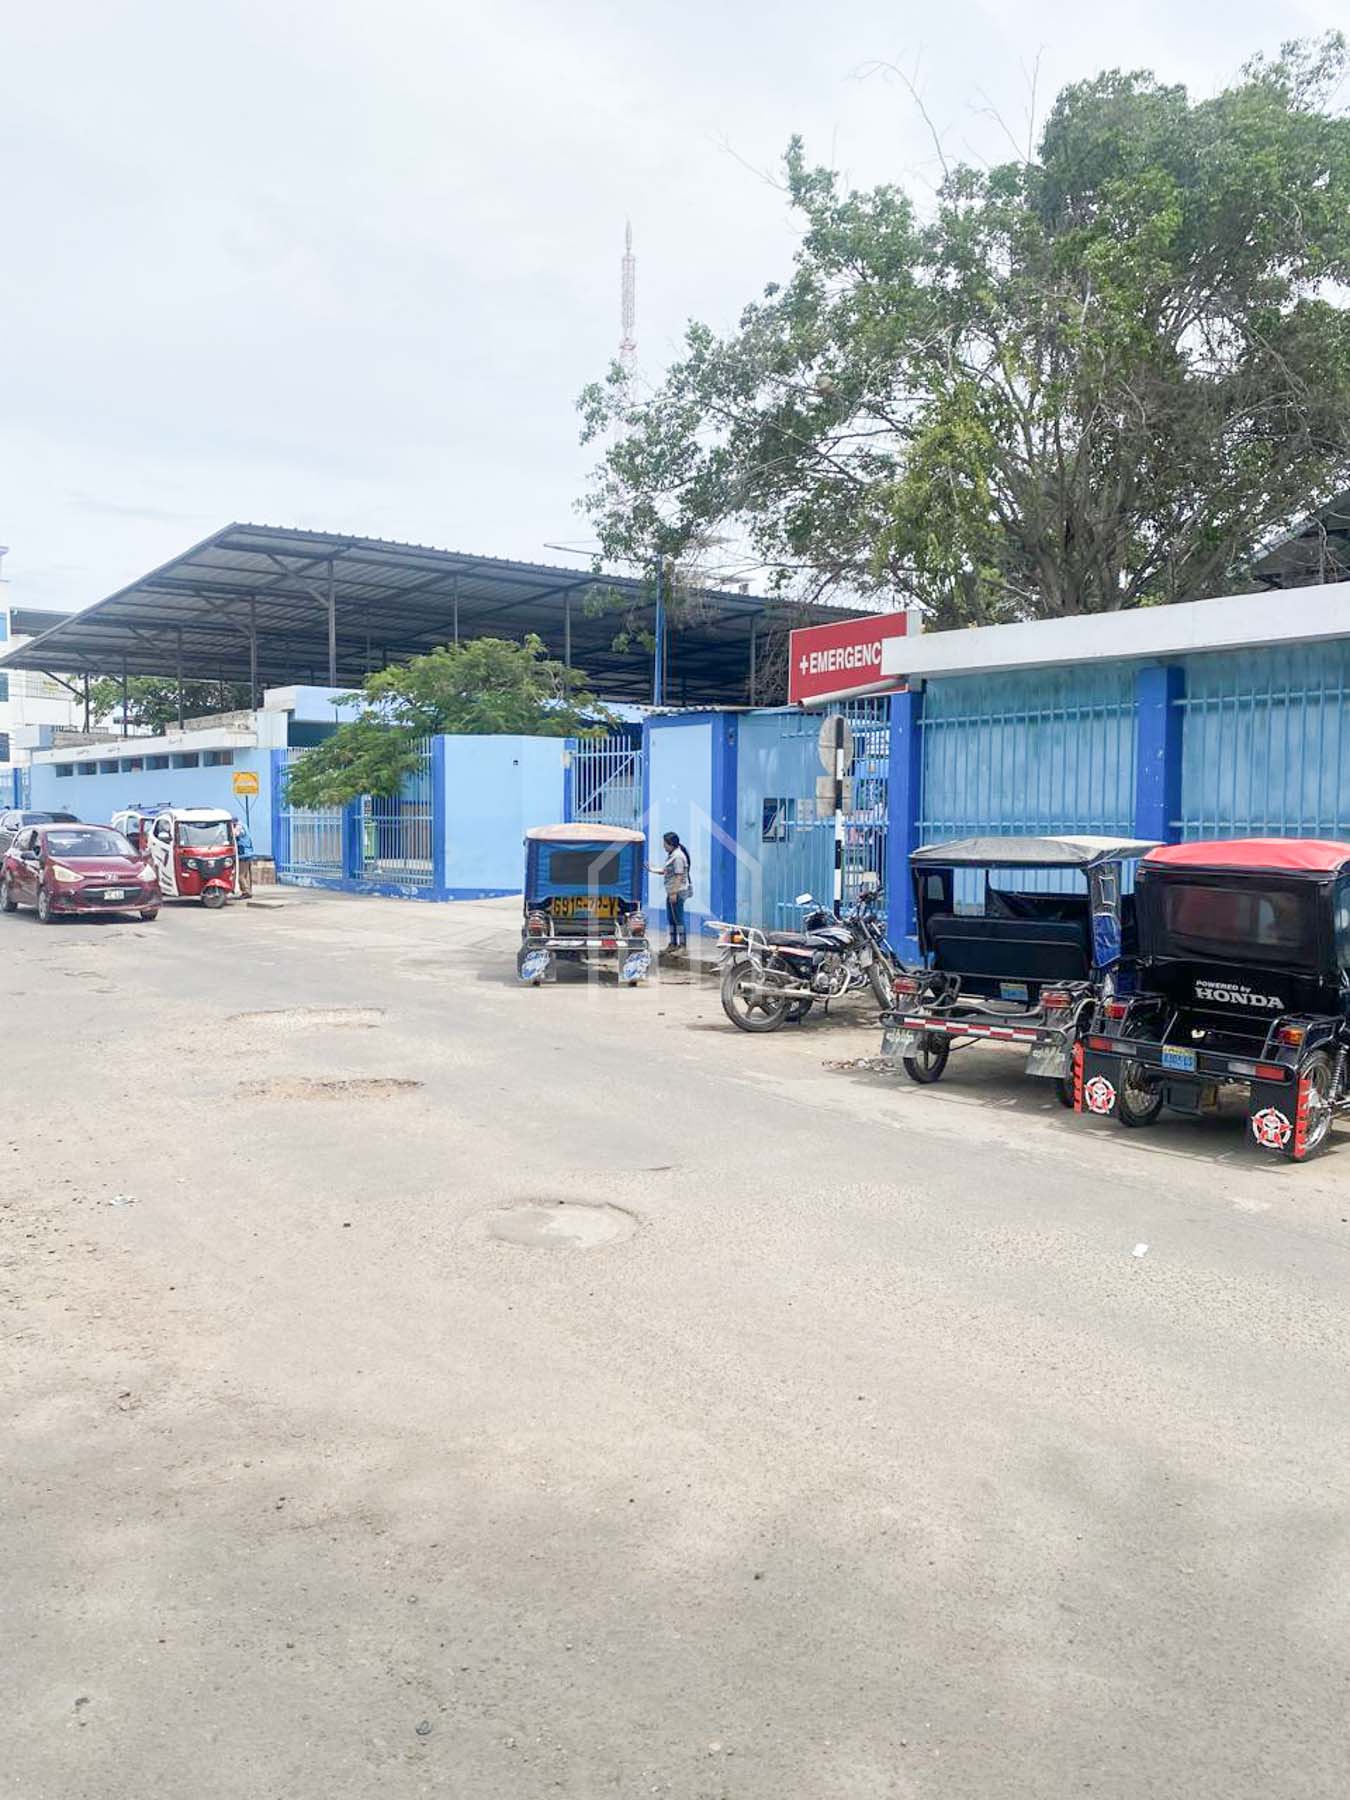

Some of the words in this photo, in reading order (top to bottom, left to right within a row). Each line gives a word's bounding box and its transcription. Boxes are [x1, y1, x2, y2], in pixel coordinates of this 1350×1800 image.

[809, 641, 881, 674] EMERGENC
[1196, 979, 1239, 991] POWERED
[1194, 986, 1285, 1010] HONDA
